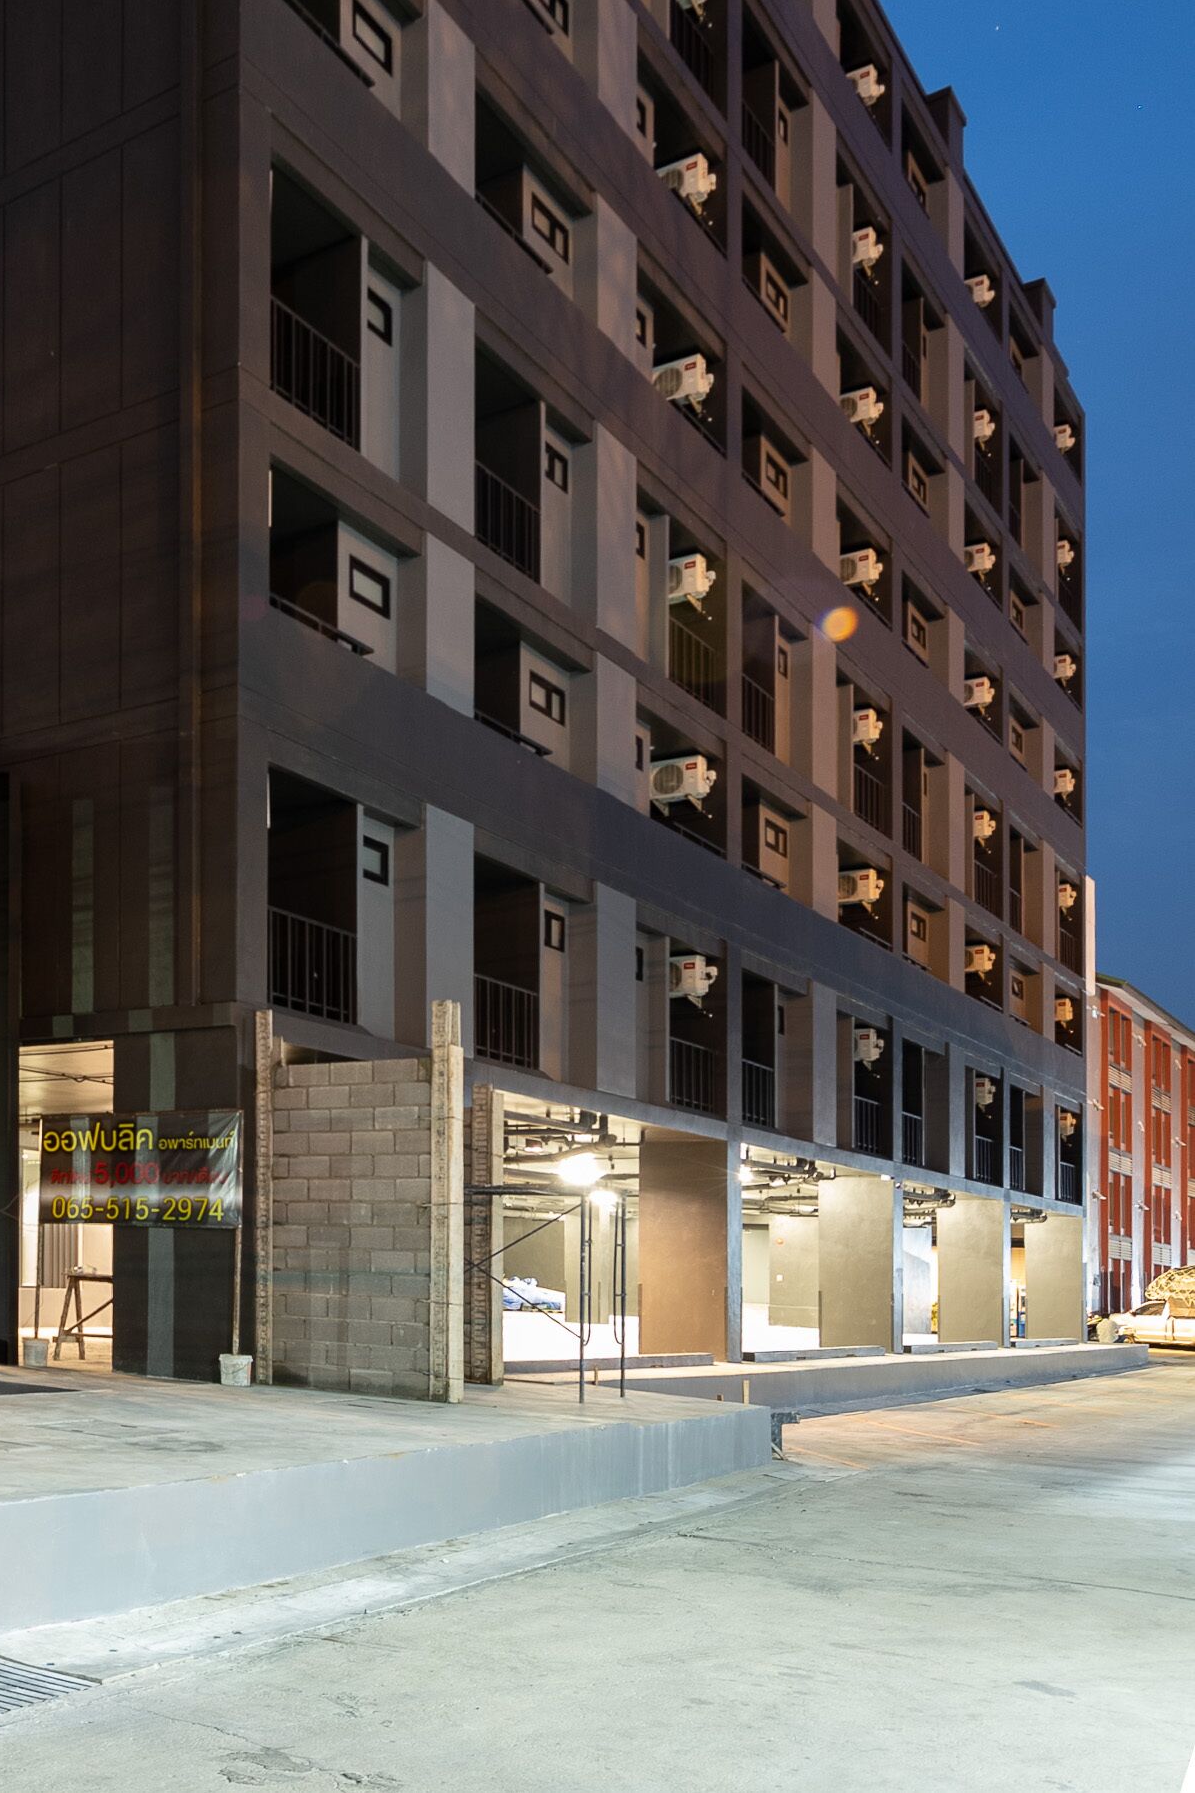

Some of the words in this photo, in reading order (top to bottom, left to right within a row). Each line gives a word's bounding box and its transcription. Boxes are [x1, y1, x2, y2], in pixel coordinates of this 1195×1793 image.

[43, 1122, 154, 1152] ออฟบลิค
[94, 1161, 160, 1187] 5,000
[52, 1195, 224, 1221] 065-515-2974
